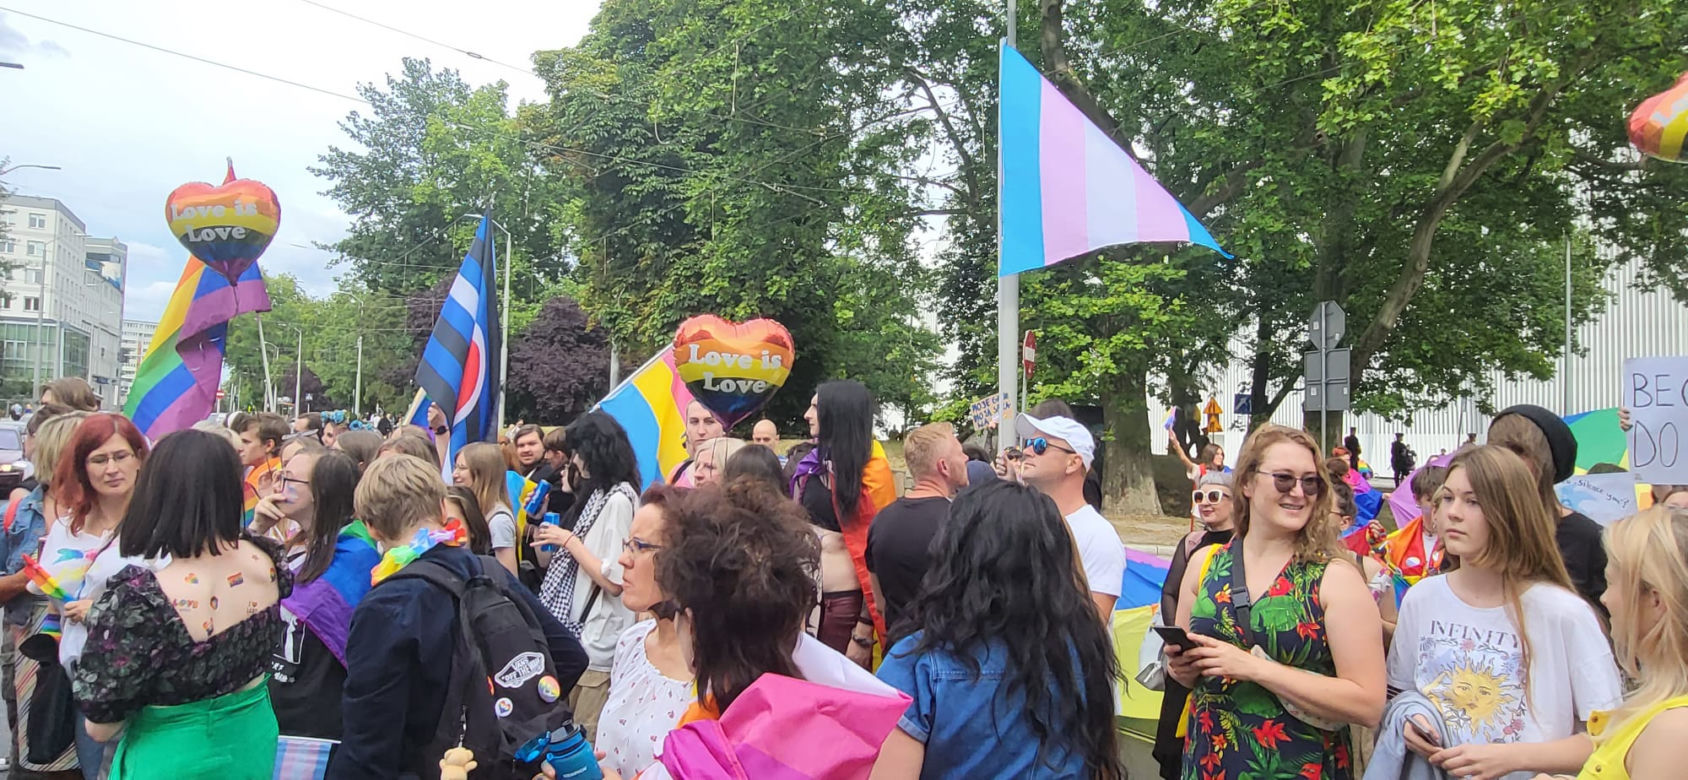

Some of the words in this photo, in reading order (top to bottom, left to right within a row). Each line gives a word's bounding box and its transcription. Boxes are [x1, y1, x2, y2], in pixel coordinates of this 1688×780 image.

[170, 204, 226, 221] Love
[233, 200, 257, 217] is
[184, 226, 247, 242] Love
[688, 343, 753, 369] Love
[760, 350, 782, 370] is
[702, 371, 767, 394] Love
[1633, 420, 1679, 468] DO
